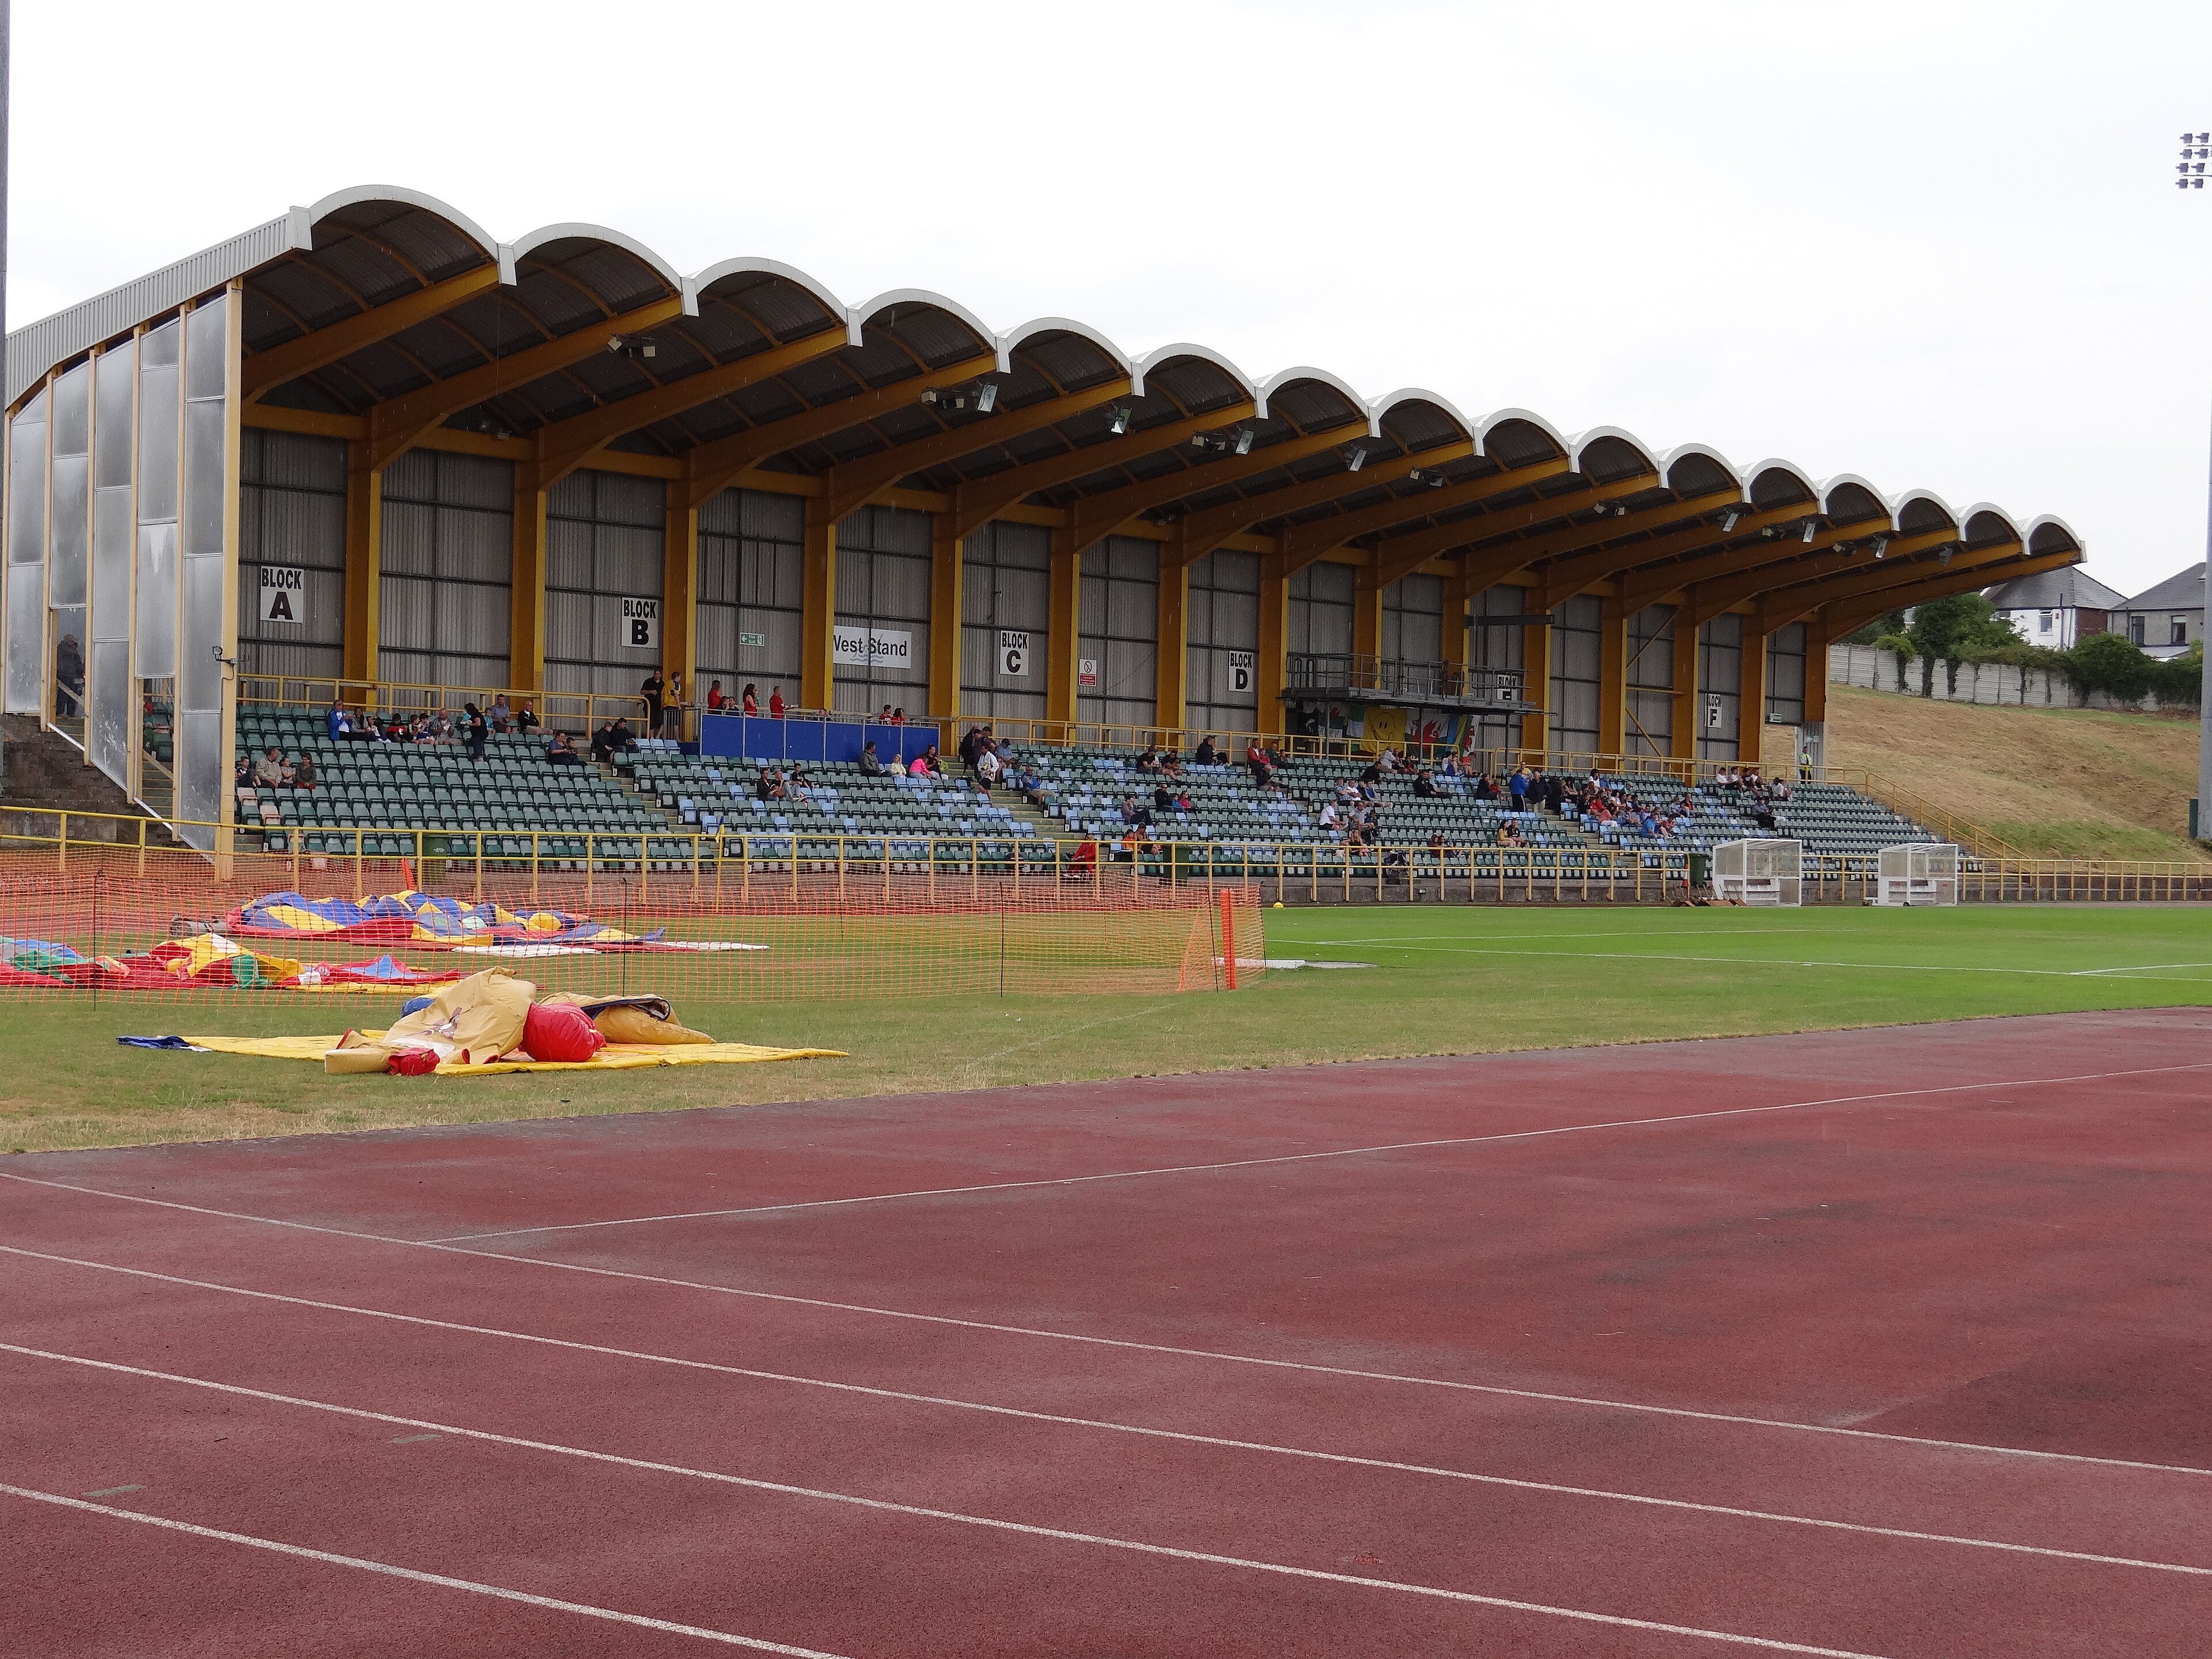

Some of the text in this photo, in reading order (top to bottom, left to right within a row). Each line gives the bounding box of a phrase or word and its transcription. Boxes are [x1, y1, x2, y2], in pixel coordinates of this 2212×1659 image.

[262, 568, 301, 589] BLOCK
[269, 592, 293, 620] A
[624, 600, 656, 619] BLOCK
[631, 619, 649, 645] B
[1002, 632, 1028, 649] BLOCK
[868, 638, 907, 656] Stand
[1006, 650, 1021, 673] C
[1230, 653, 1252, 668] BLOCK
[1236, 669, 1248, 690] D
[1709, 695, 1721, 707] LOCK
[1710, 709, 1717, 726] F
